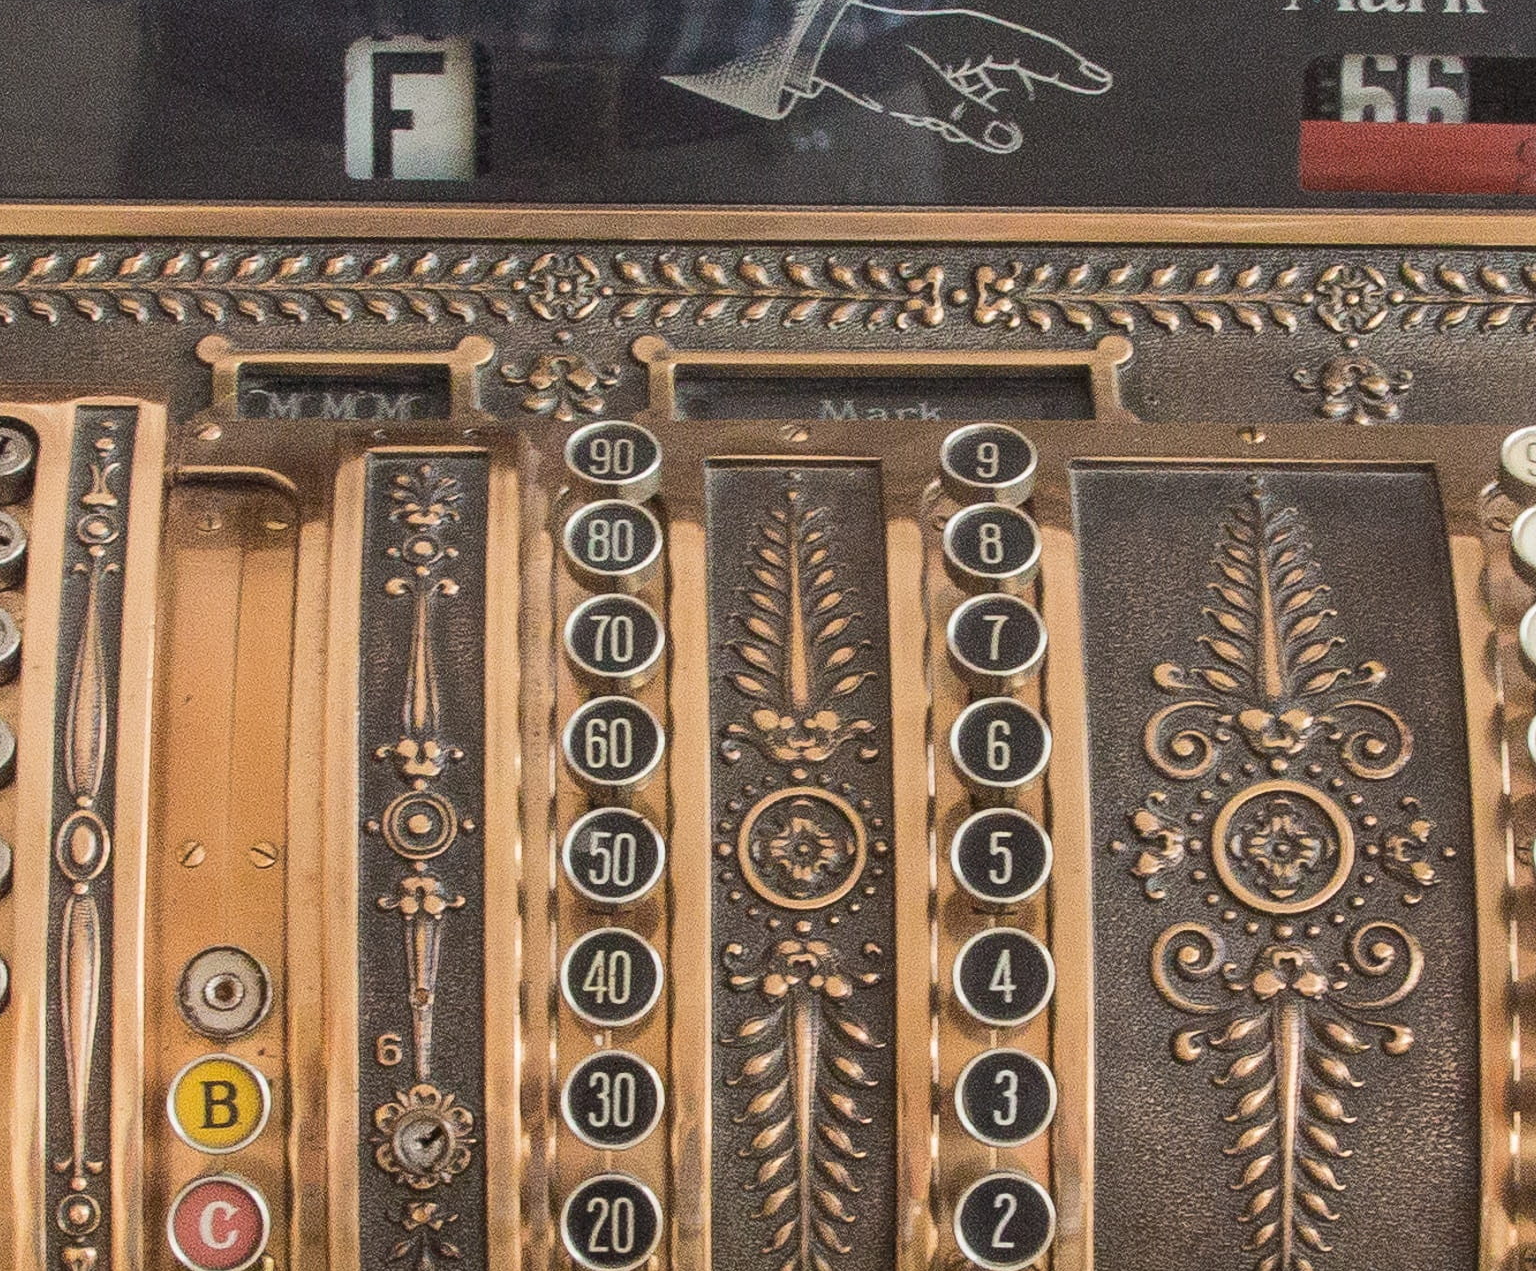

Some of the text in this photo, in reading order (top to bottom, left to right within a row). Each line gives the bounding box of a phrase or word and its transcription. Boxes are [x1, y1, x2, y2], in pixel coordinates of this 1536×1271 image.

[372, 51, 445, 180] F
[589, 438, 635, 475] 90
[976, 442, 1000, 478] 9
[587, 519, 635, 562] 80
[979, 523, 1004, 564] 8
[590, 615, 634, 662] 70
[982, 615, 1009, 661] 7
[584, 717, 633, 769] 60
[987, 720, 1011, 771] 6
[588, 832, 637, 887] 50
[989, 831, 1014, 884] 5
[583, 950, 631, 1004] 40
[988, 949, 1016, 1003] 4
[376, 1033, 403, 1066] 6
[199, 1080, 242, 1129] B
[588, 1072, 636, 1127] 30
[993, 1069, 1018, 1126] 3
[198, 1200, 240, 1250] C
[586, 1196, 635, 1253] 20
[991, 1193, 1017, 1248] 2
